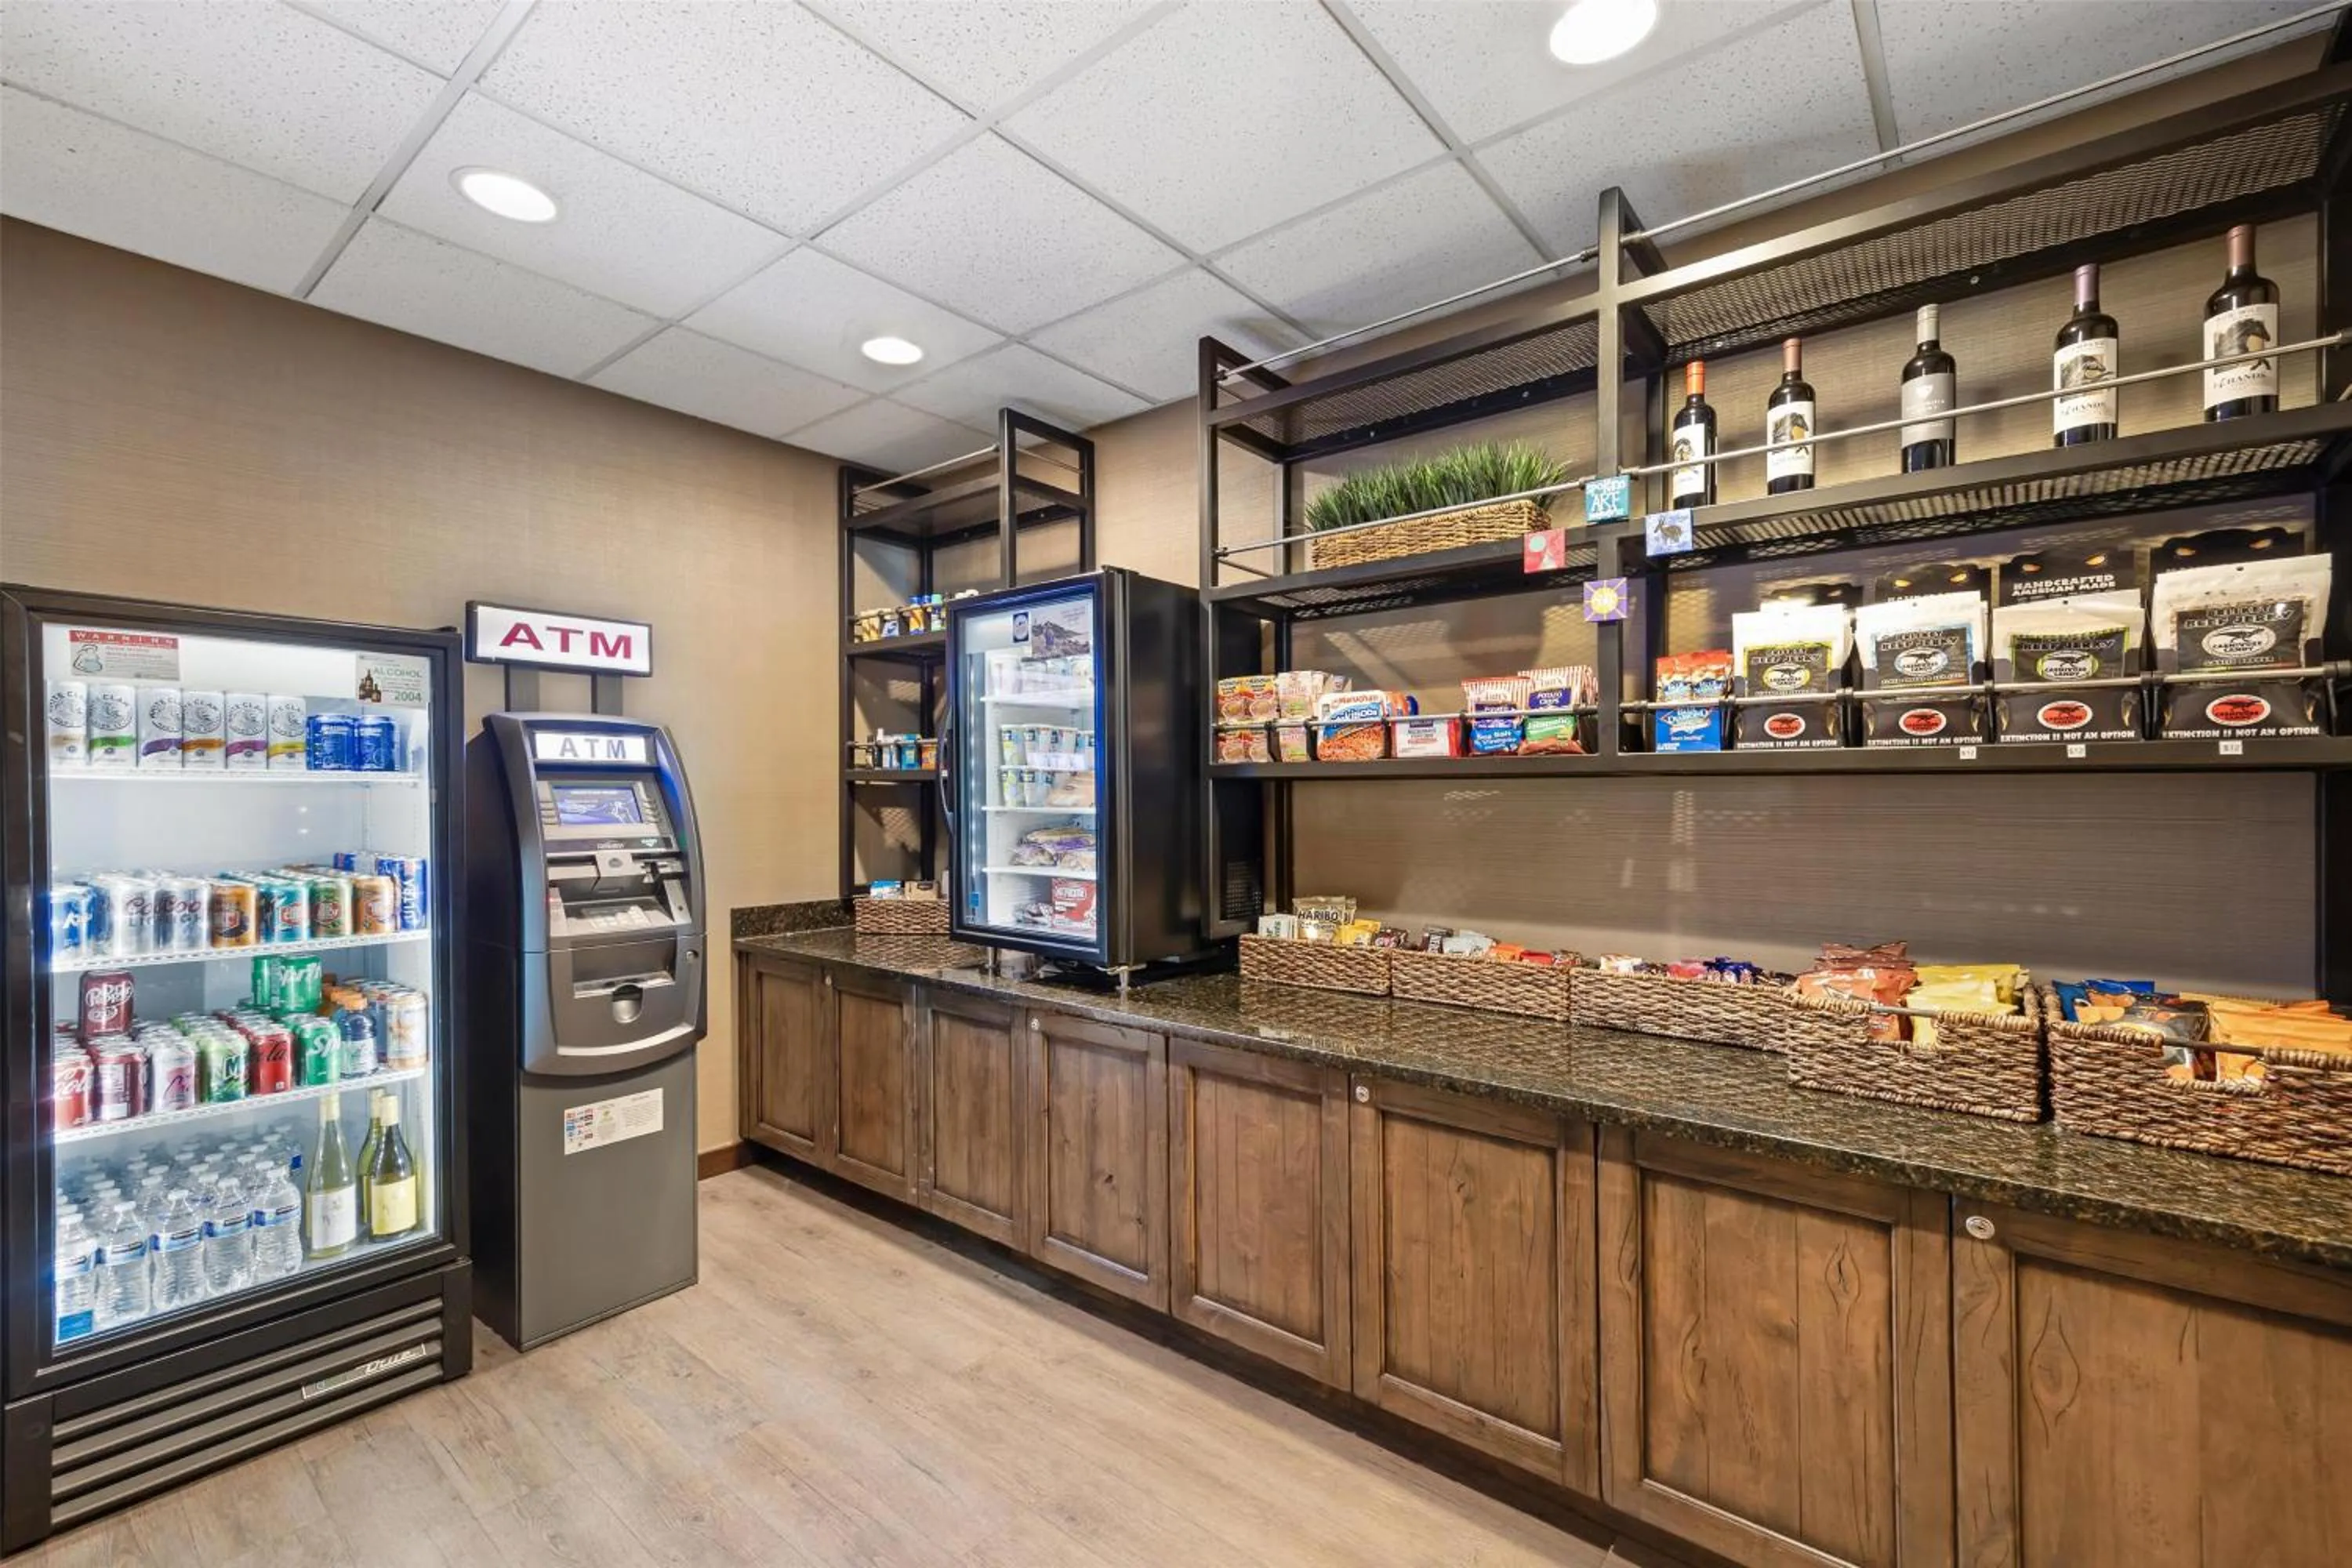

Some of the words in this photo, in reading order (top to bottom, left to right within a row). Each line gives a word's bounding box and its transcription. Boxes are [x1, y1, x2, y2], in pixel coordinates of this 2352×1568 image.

[2013, 575, 2114, 590] HANDCRAFTED
[2078, 582, 2116, 590] MADE
[499, 622, 632, 659] ATM
[373, 666, 423, 678] ALCOHOL
[394, 690, 423, 703] 2004
[2001, 734, 2049, 742] EXTINCTION
[2063, 732, 2082, 741] NOT
[2101, 730, 2135, 739] OPTION
[2162, 730, 2220, 739] EXTINCTION
[2279, 726, 2319, 735] OPTION
[1813, 739, 1838, 747] OPTION
[1953, 735, 1983, 744] OPTION
[559, 737, 626, 759] ATM
[401, 876, 415, 924] ULTRA
[1298, 910, 1338, 921] HARIBO
